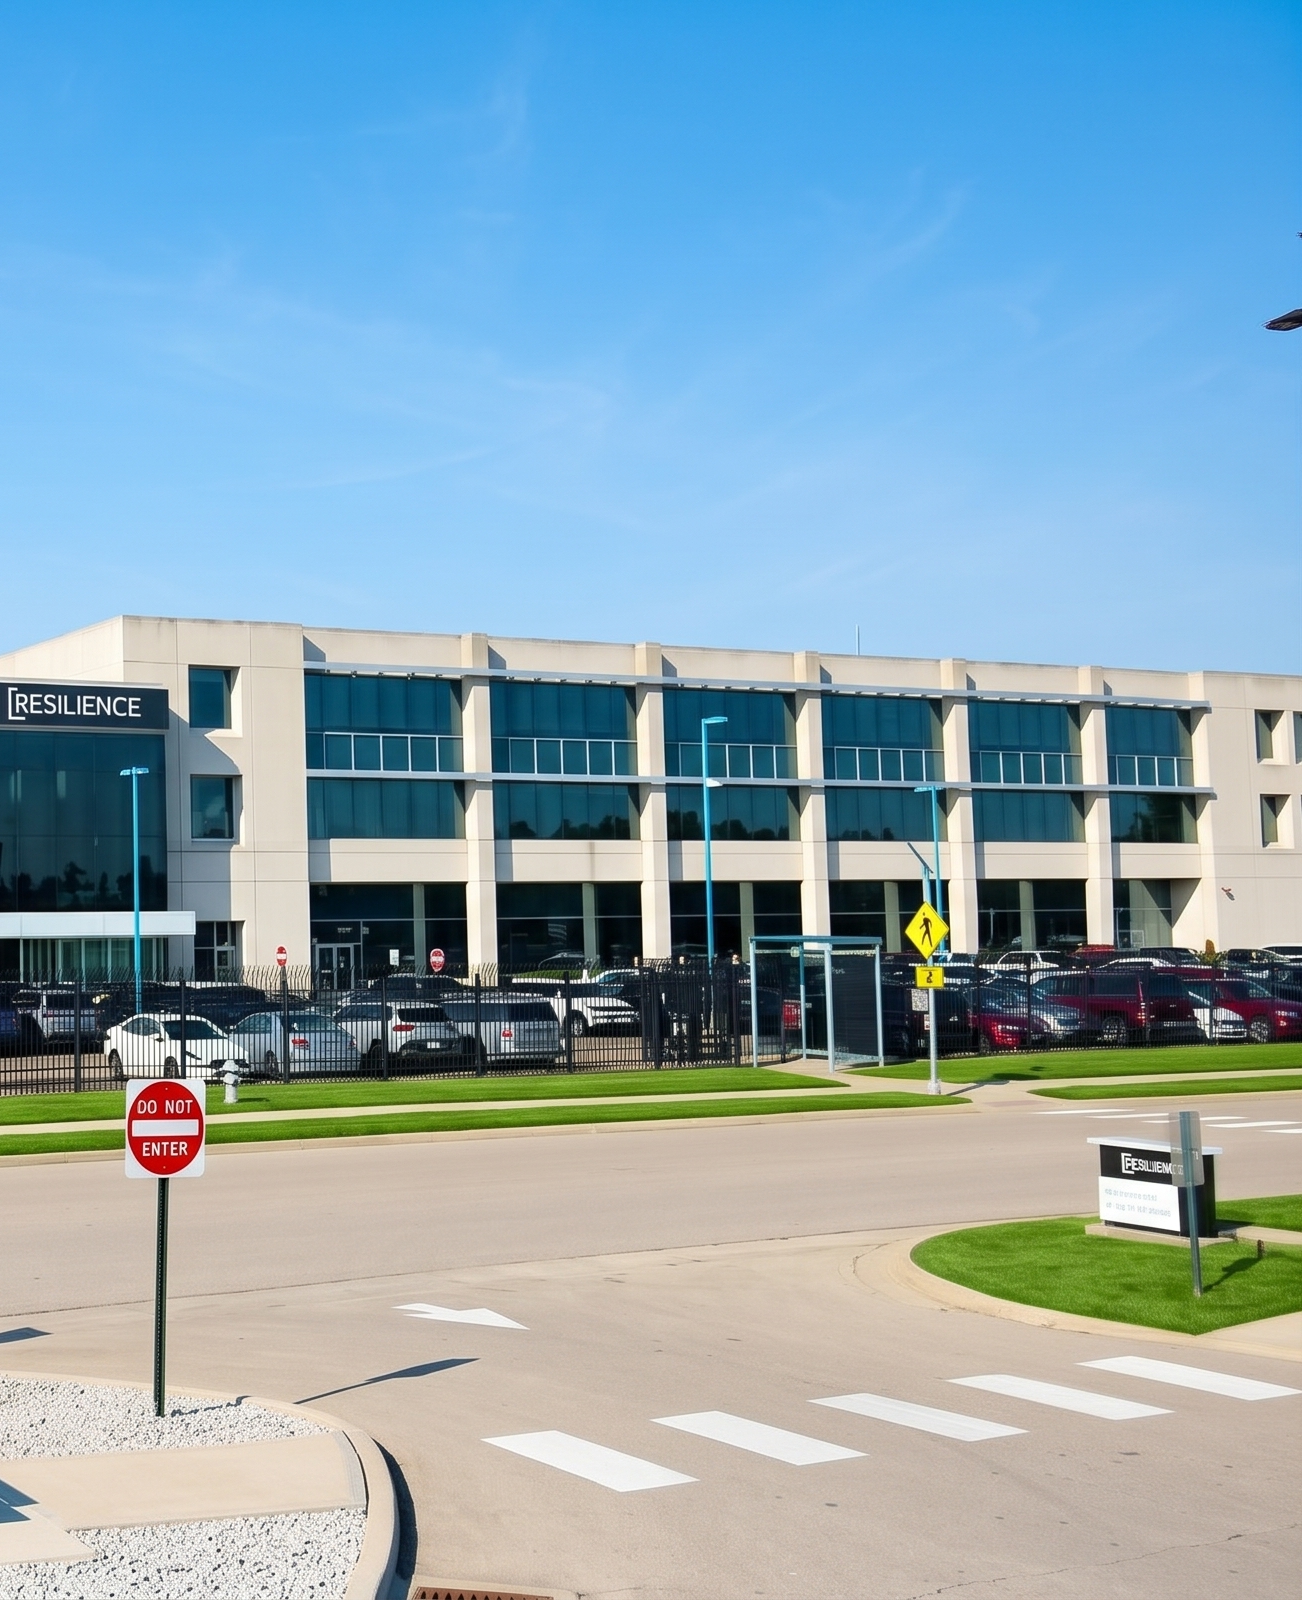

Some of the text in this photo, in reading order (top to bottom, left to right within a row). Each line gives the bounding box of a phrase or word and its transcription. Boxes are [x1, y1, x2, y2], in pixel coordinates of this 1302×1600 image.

[14, 693, 142, 718] RESILIENCE
[137, 1099, 194, 1115] DO NOT
[142, 1141, 188, 1157] ENTER
